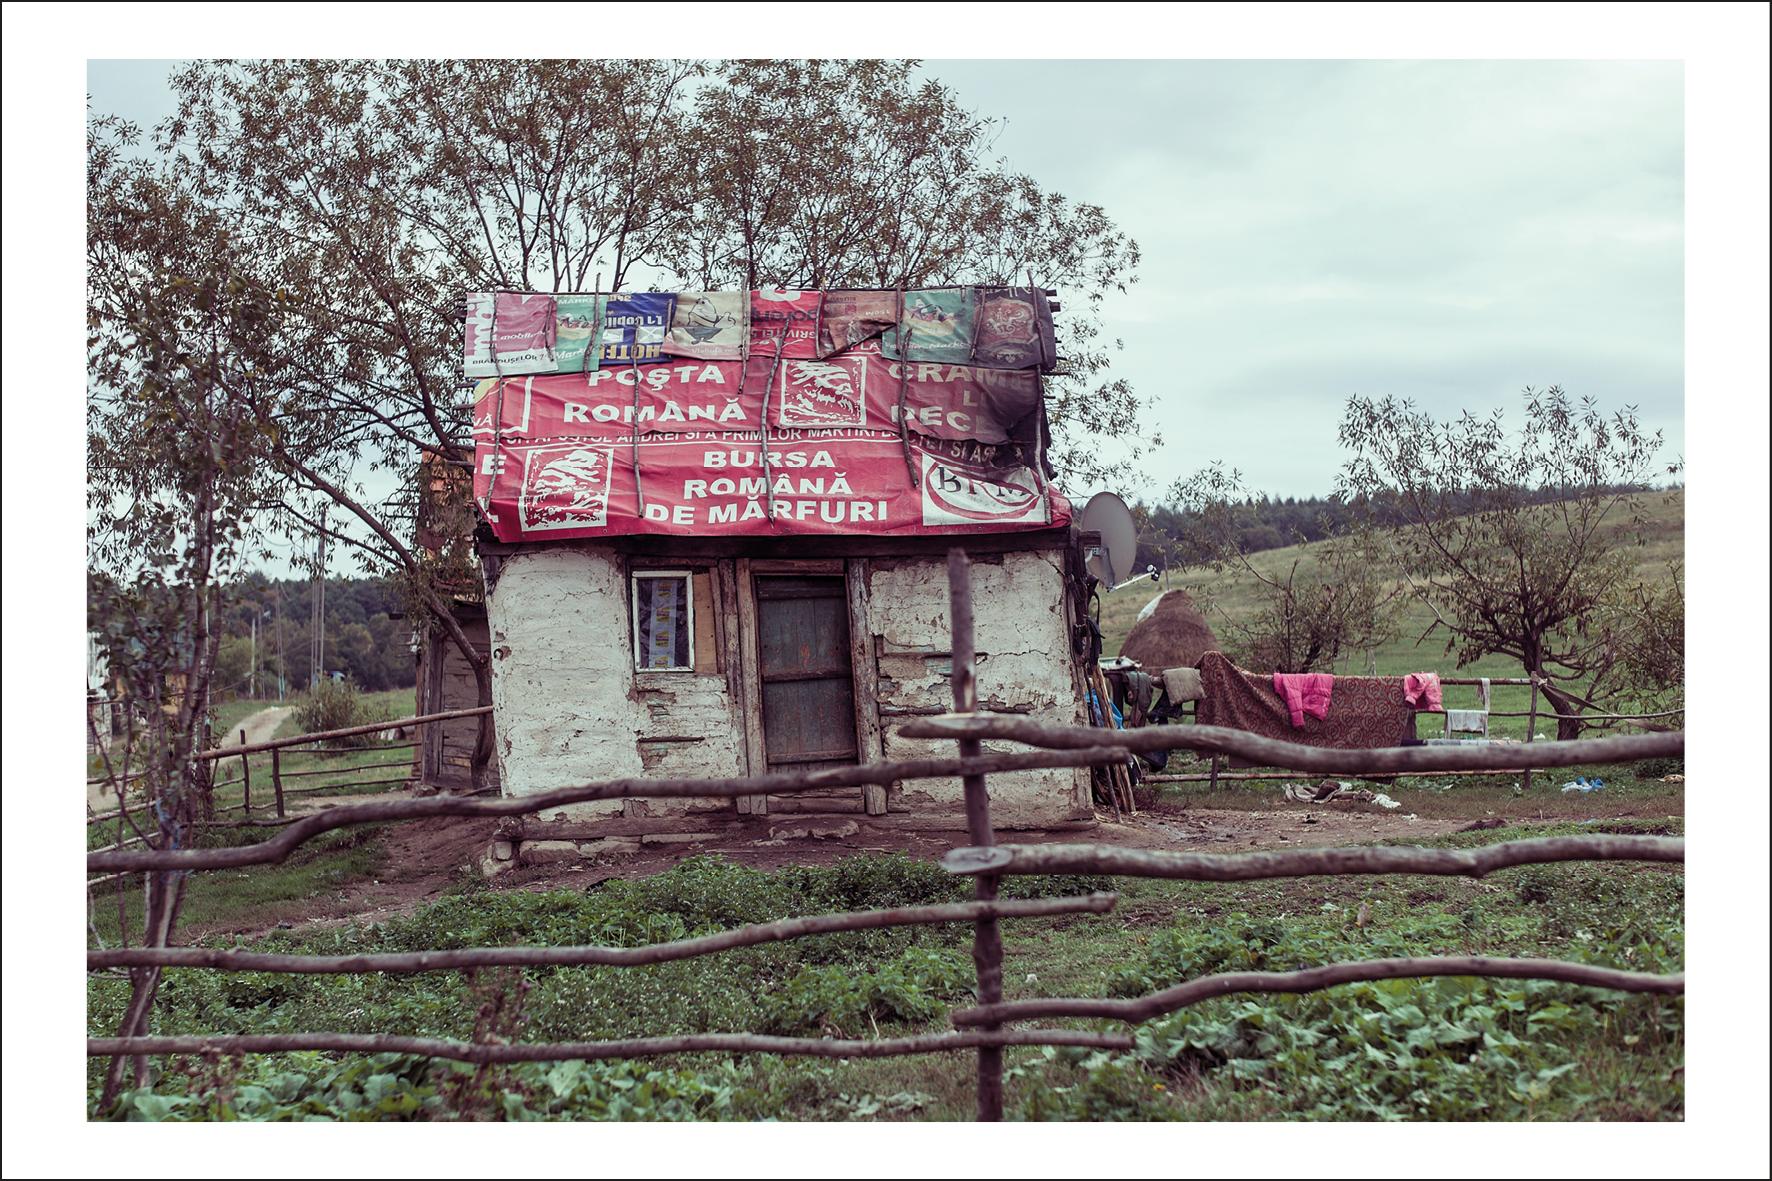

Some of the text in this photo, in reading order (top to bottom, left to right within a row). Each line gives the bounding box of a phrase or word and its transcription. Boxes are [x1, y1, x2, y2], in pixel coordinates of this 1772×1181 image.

[563, 398, 747, 423] ROMÂNĂ
[722, 429, 802, 441] PRIMLOR
[474, 454, 507, 475] E
[703, 450, 836, 468] BURSA
[683, 472, 854, 499] ROMÂNĂ
[645, 496, 888, 525] DE MĂRFURI
